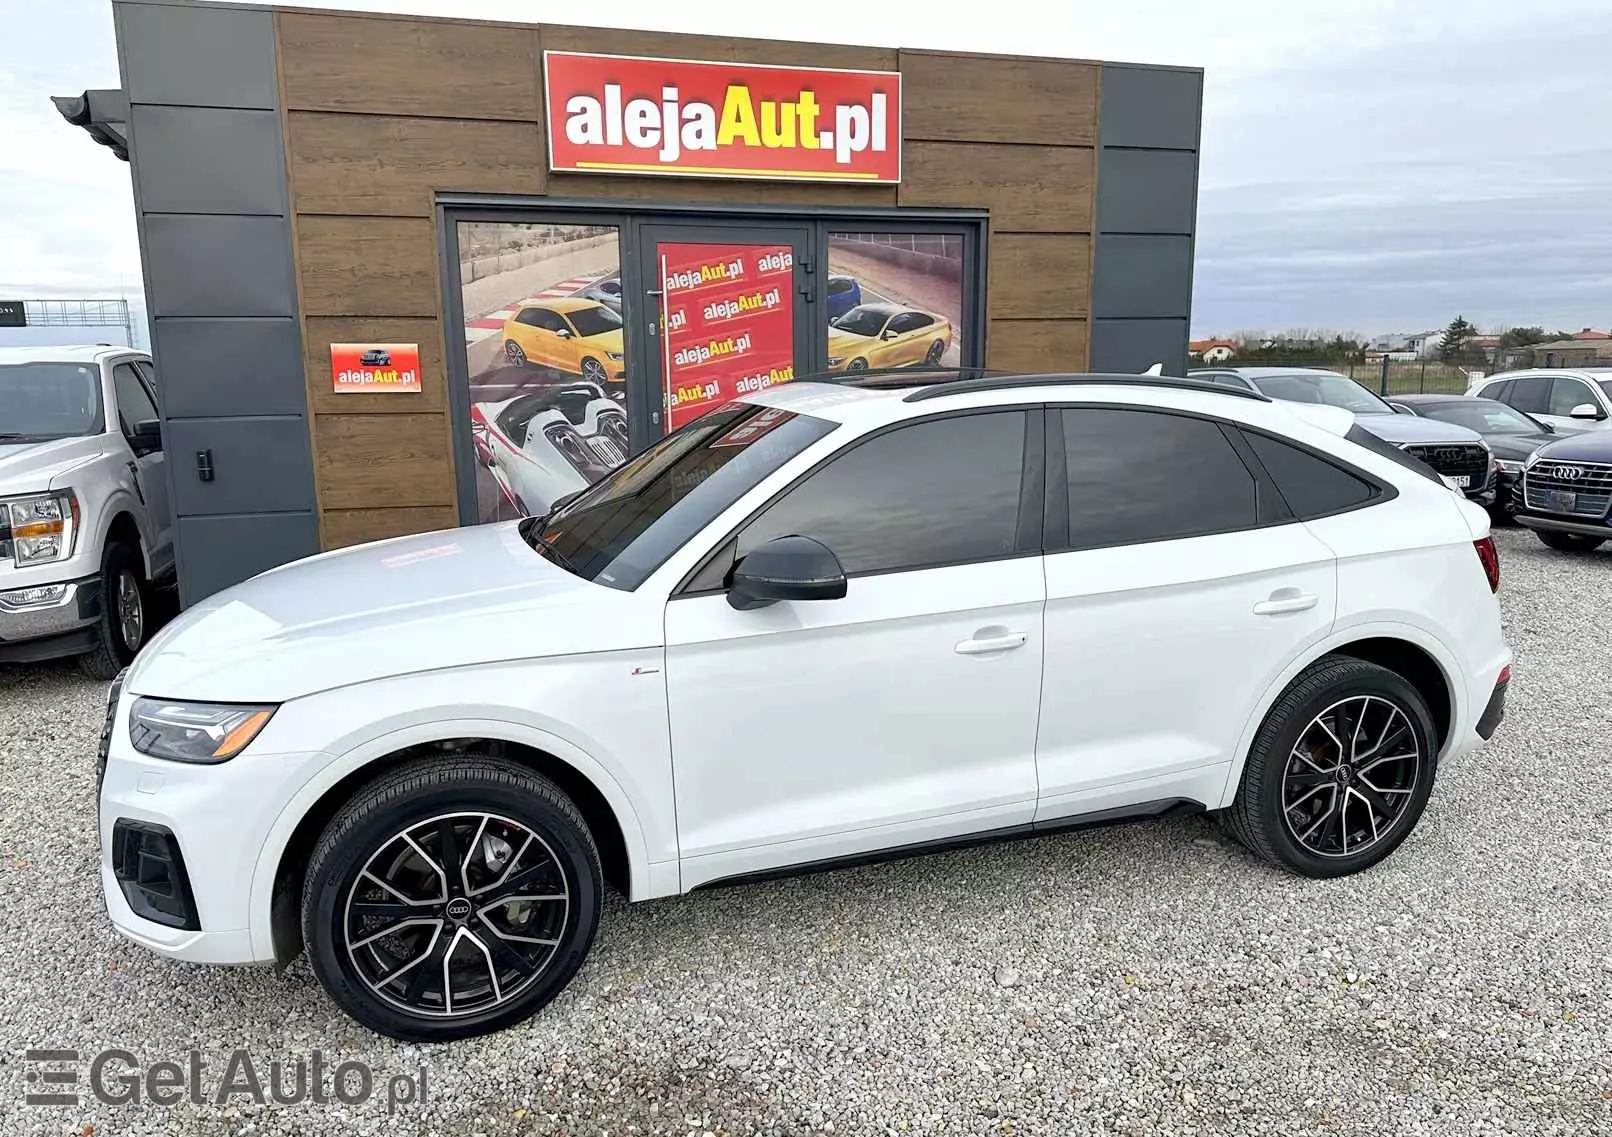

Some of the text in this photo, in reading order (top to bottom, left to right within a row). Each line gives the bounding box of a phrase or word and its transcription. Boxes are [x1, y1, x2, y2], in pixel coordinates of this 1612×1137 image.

[565, 83, 887, 163] alejaAut.pl
[666, 258, 744, 289] alejaAut.pl
[703, 288, 780, 319] alejaAut.pl
[674, 334, 752, 365] alejaAut.pl
[338, 368, 416, 386] alejaAut.pl
